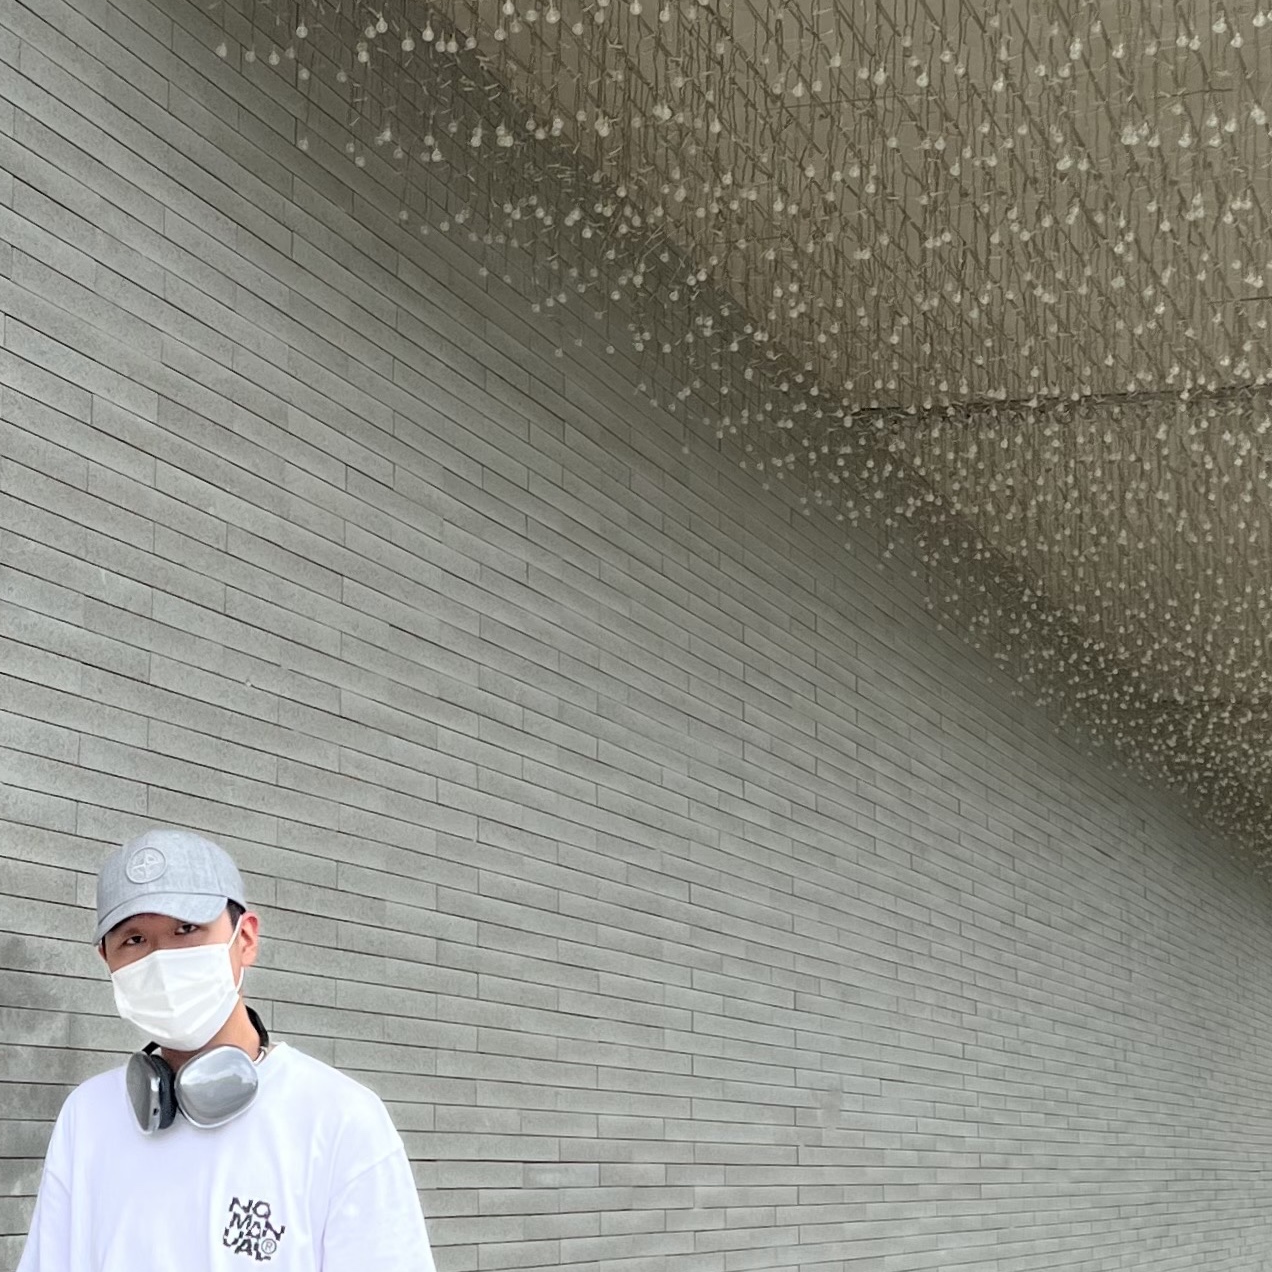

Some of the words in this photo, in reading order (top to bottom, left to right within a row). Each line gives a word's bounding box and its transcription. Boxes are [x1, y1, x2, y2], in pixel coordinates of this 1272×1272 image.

[229, 1197, 271, 1220] NO
[229, 1211, 285, 1241] MAN
[223, 1227, 271, 1261] UAL
